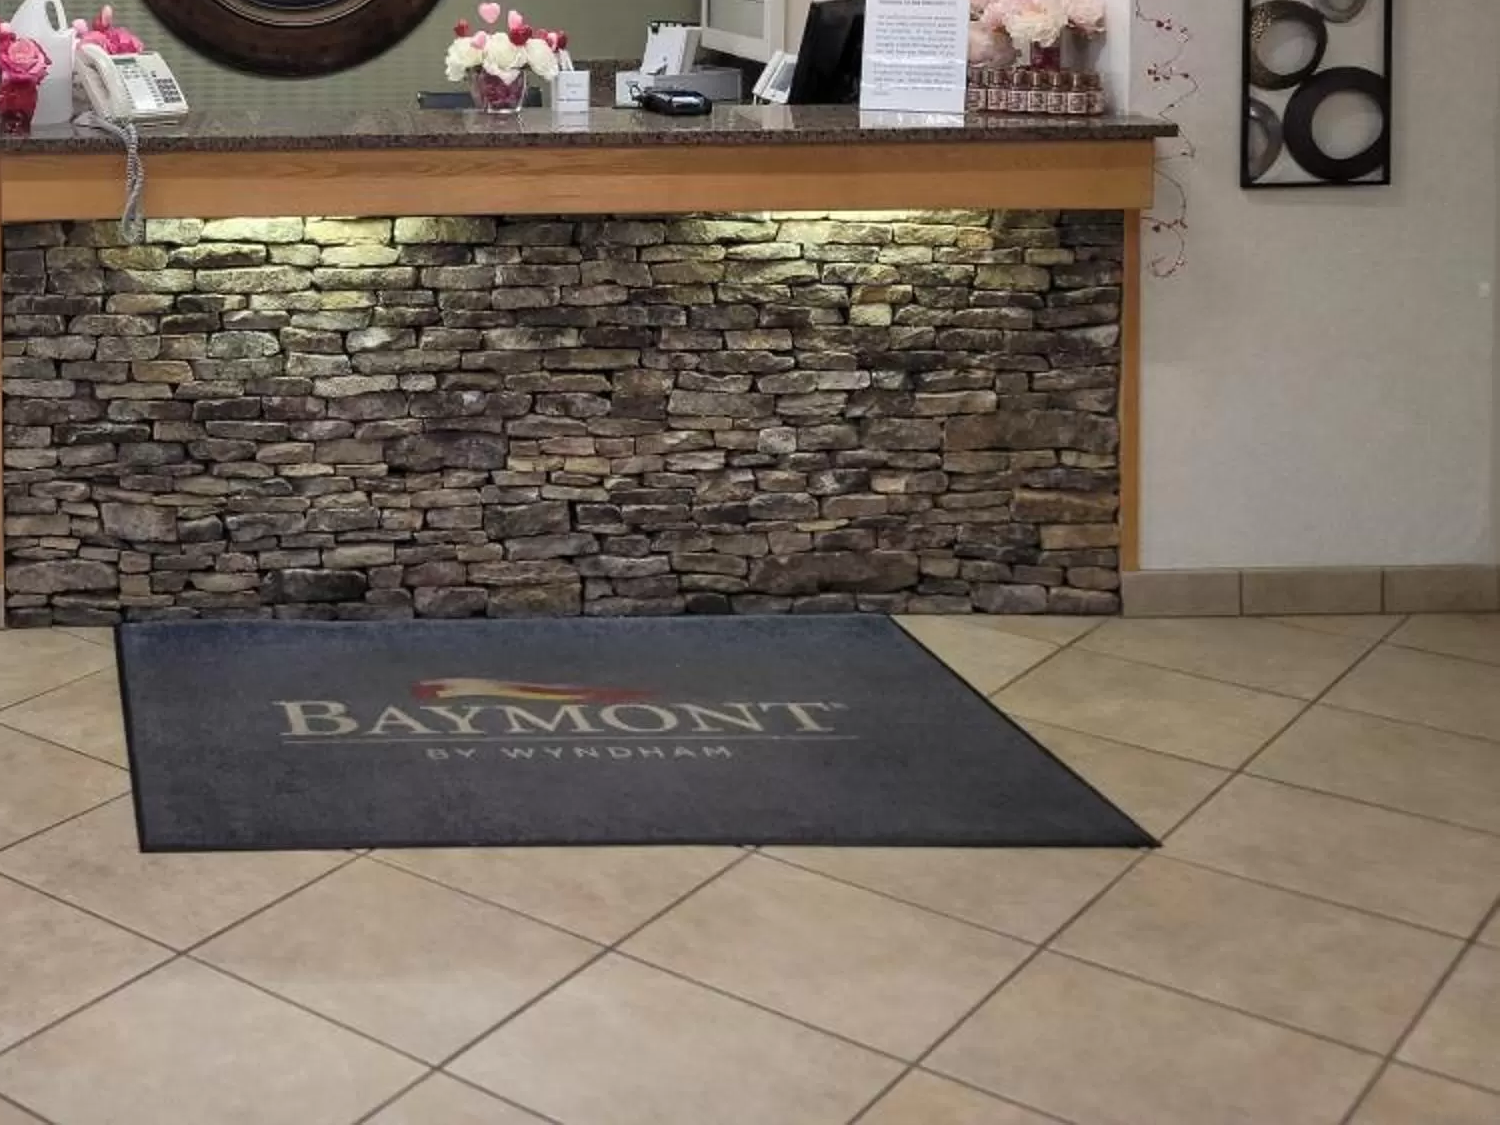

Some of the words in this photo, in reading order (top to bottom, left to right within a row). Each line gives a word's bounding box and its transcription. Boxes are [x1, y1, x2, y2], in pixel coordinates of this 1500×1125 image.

[272, 699, 838, 736] BAYMONT
[424, 747, 477, 760] BY
[502, 746, 733, 760] WYNDHAM
